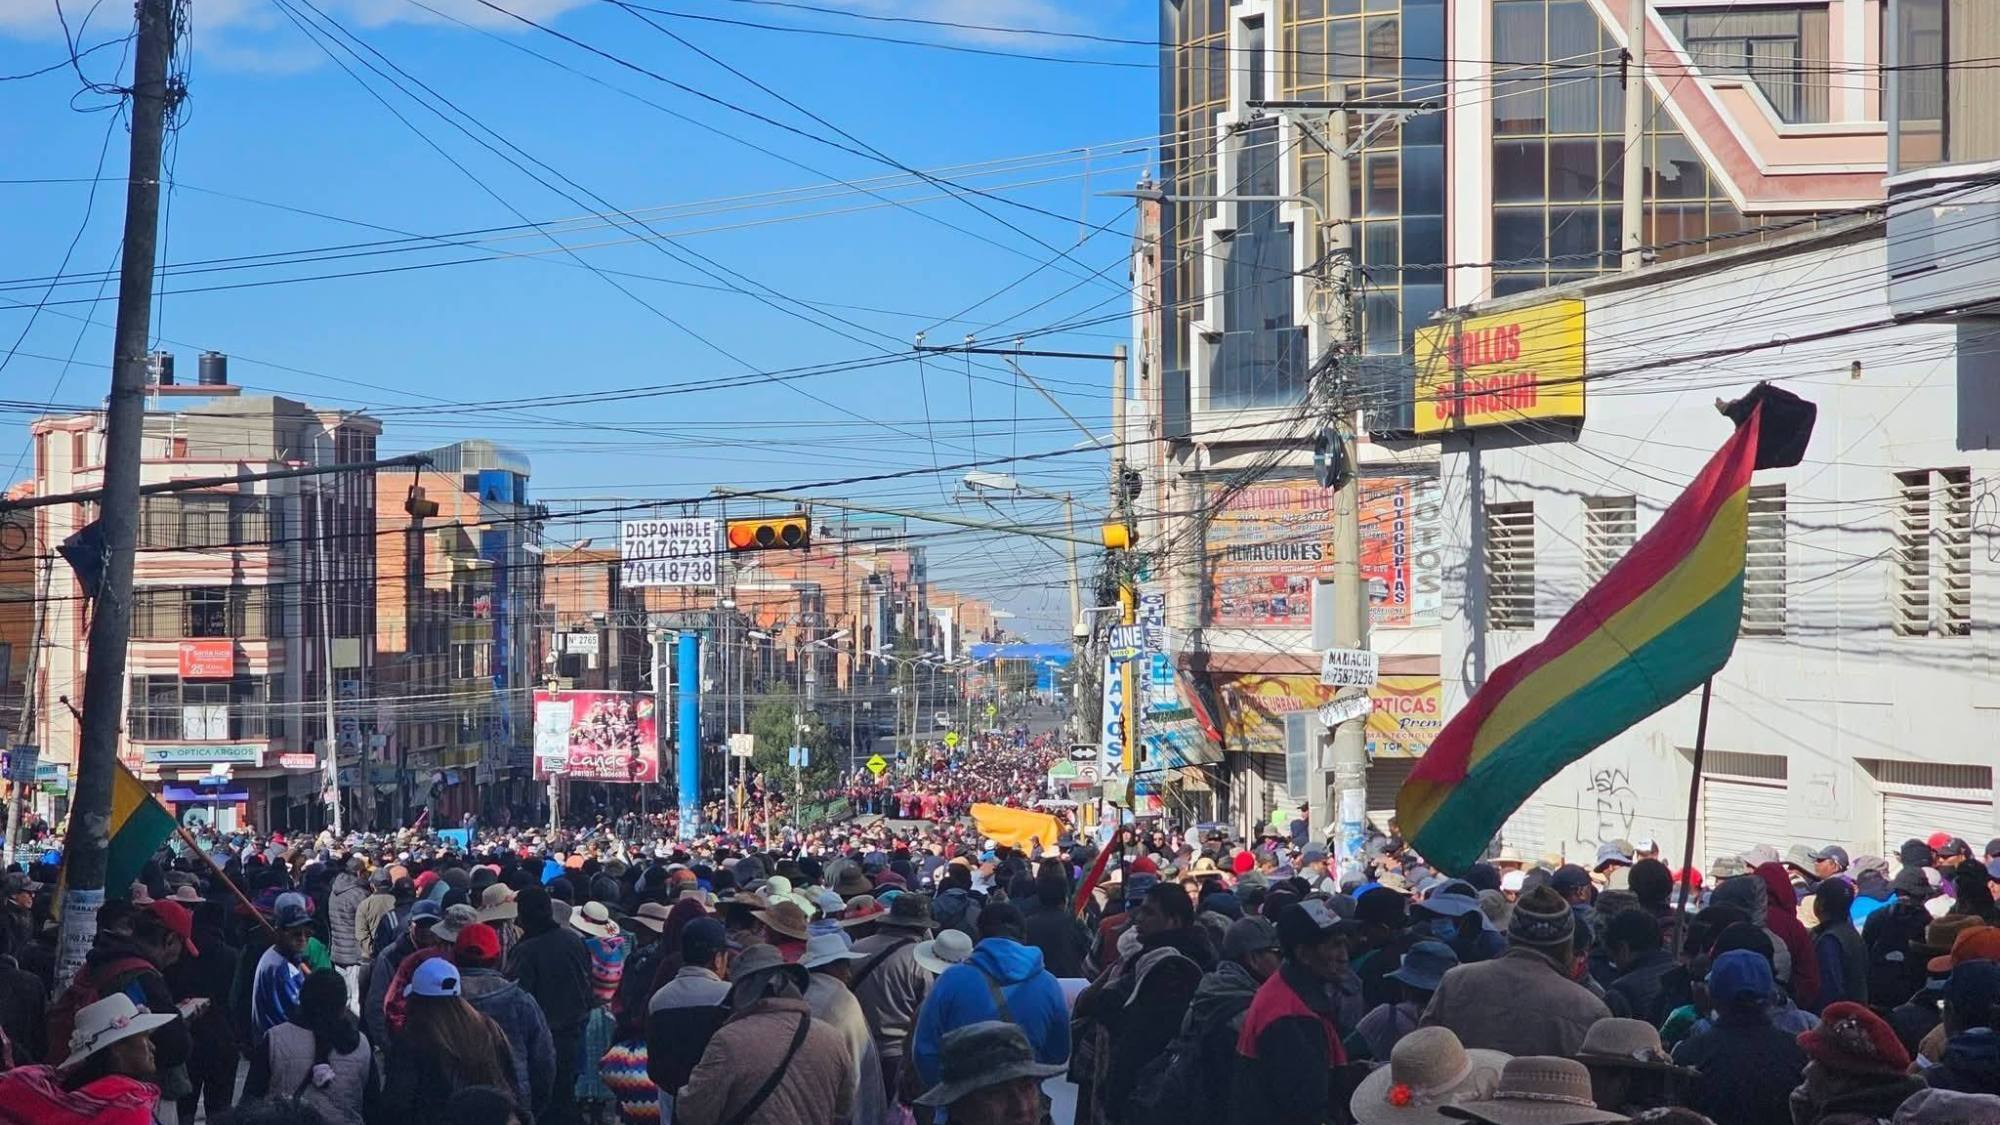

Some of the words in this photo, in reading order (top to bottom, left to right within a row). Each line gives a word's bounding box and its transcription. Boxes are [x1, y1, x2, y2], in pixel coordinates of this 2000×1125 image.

[1447, 323, 1521, 369] POLLOS
[625, 522, 711, 538] DISPONIBLE
[625, 539, 712, 560] 70176733
[627, 561, 713, 583] 70118738
[579, 636, 597, 645] 2765
[1110, 626, 1142, 648] CINE
[1328, 651, 1371, 667] MARIACHI
[1371, 697, 1437, 714] PTICAS
